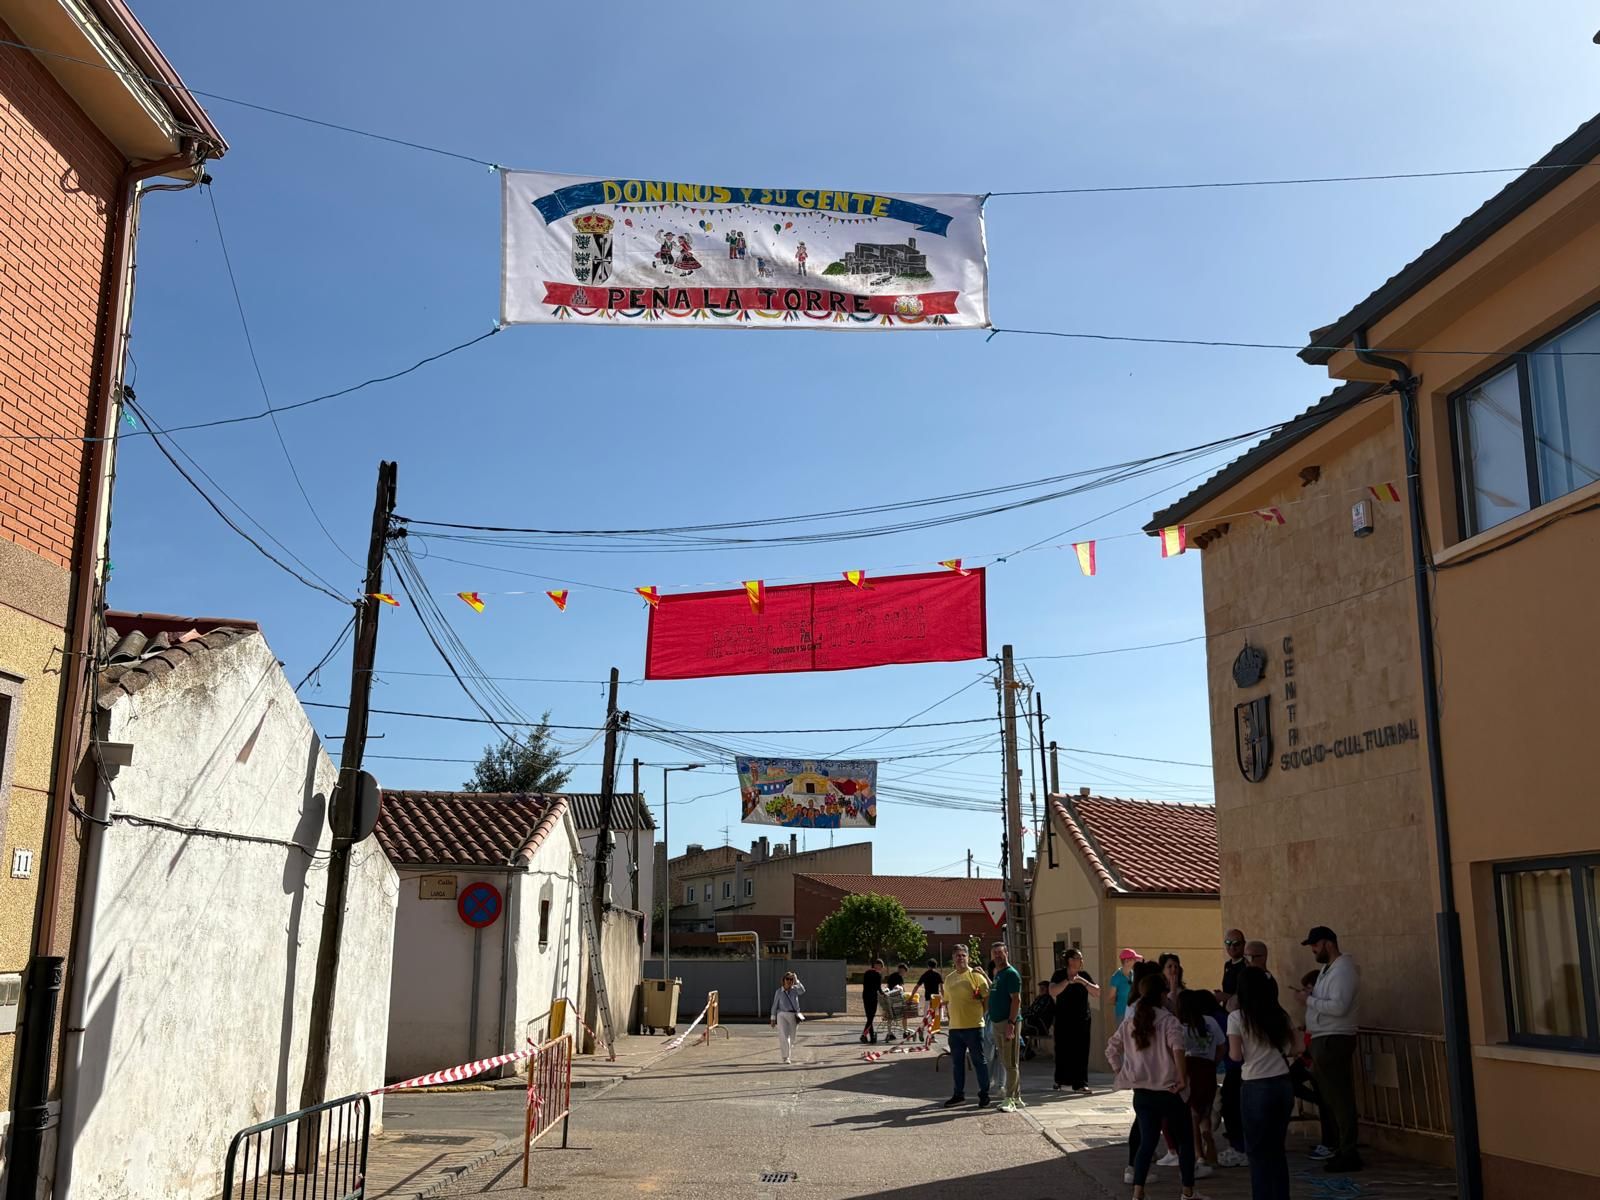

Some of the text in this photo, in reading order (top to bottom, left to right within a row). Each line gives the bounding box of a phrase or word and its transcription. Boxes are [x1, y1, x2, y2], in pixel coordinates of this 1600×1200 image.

[741, 188, 753, 203] Y
[760, 188, 787, 204] SU
[797, 190, 890, 217] GENTE
[607, 286, 871, 313] PEÑA LA TORRE
[17, 855, 29, 872] 11
